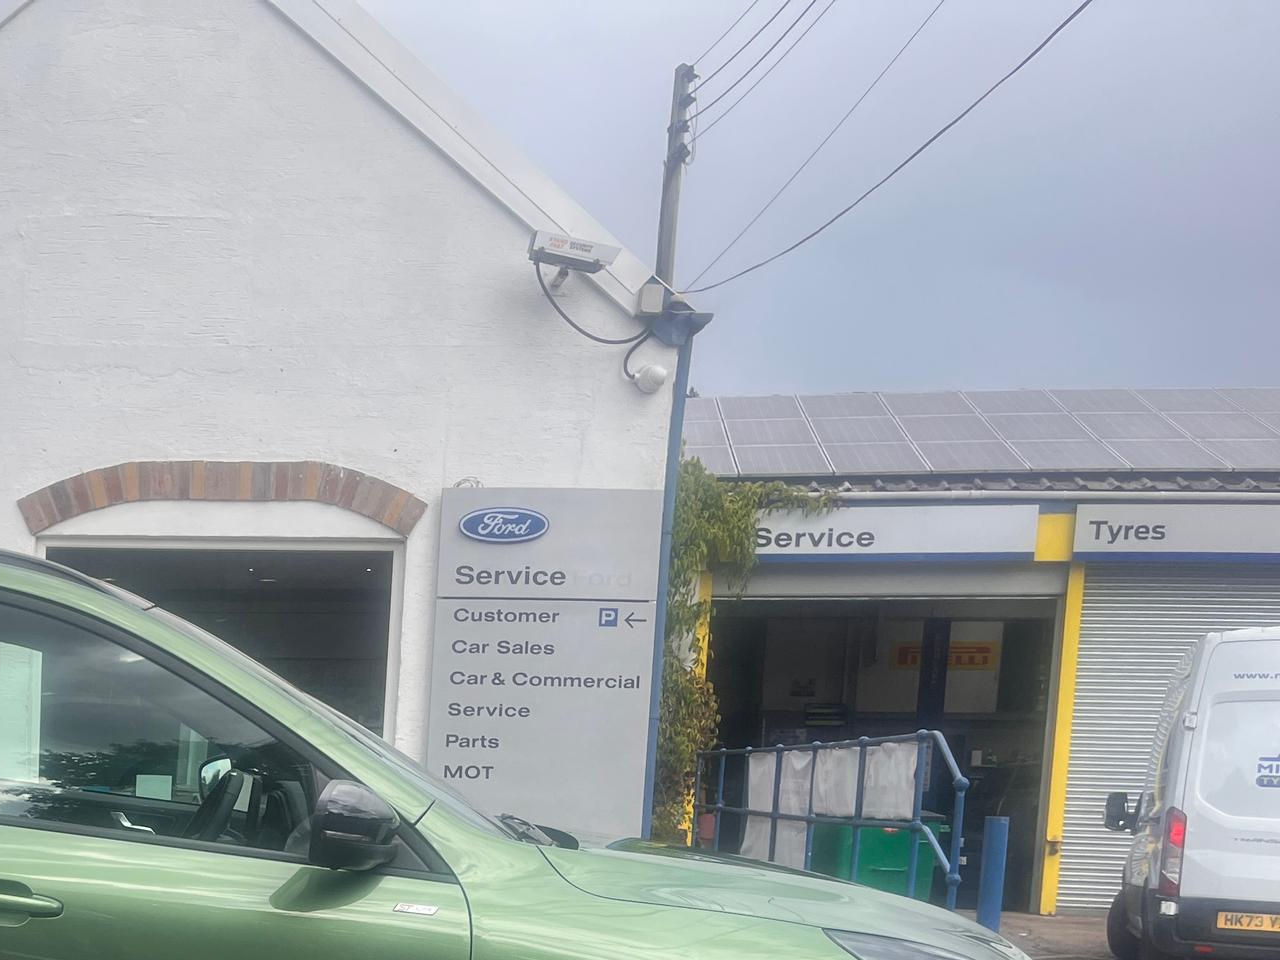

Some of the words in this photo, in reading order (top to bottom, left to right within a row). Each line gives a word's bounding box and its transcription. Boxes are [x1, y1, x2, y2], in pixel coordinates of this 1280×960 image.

[478, 512, 532, 535] Ford
[1088, 519, 1167, 544] Tyres
[754, 527, 875, 548] Service
[454, 565, 567, 586] Service
[453, 608, 560, 623] Customer
[451, 639, 490, 654] Car
[496, 640, 555, 655] Sales
[895, 646, 992, 667] PILLI
[449, 671, 488, 685] Car
[491, 672, 506, 686] &
[512, 672, 641, 689] Commercial
[447, 702, 531, 718] Service
[445, 734, 500, 749] Parts
[443, 765, 494, 780] MOT
[1224, 913, 1264, 928] HK73
[1269, 916, 1280, 929] Y
